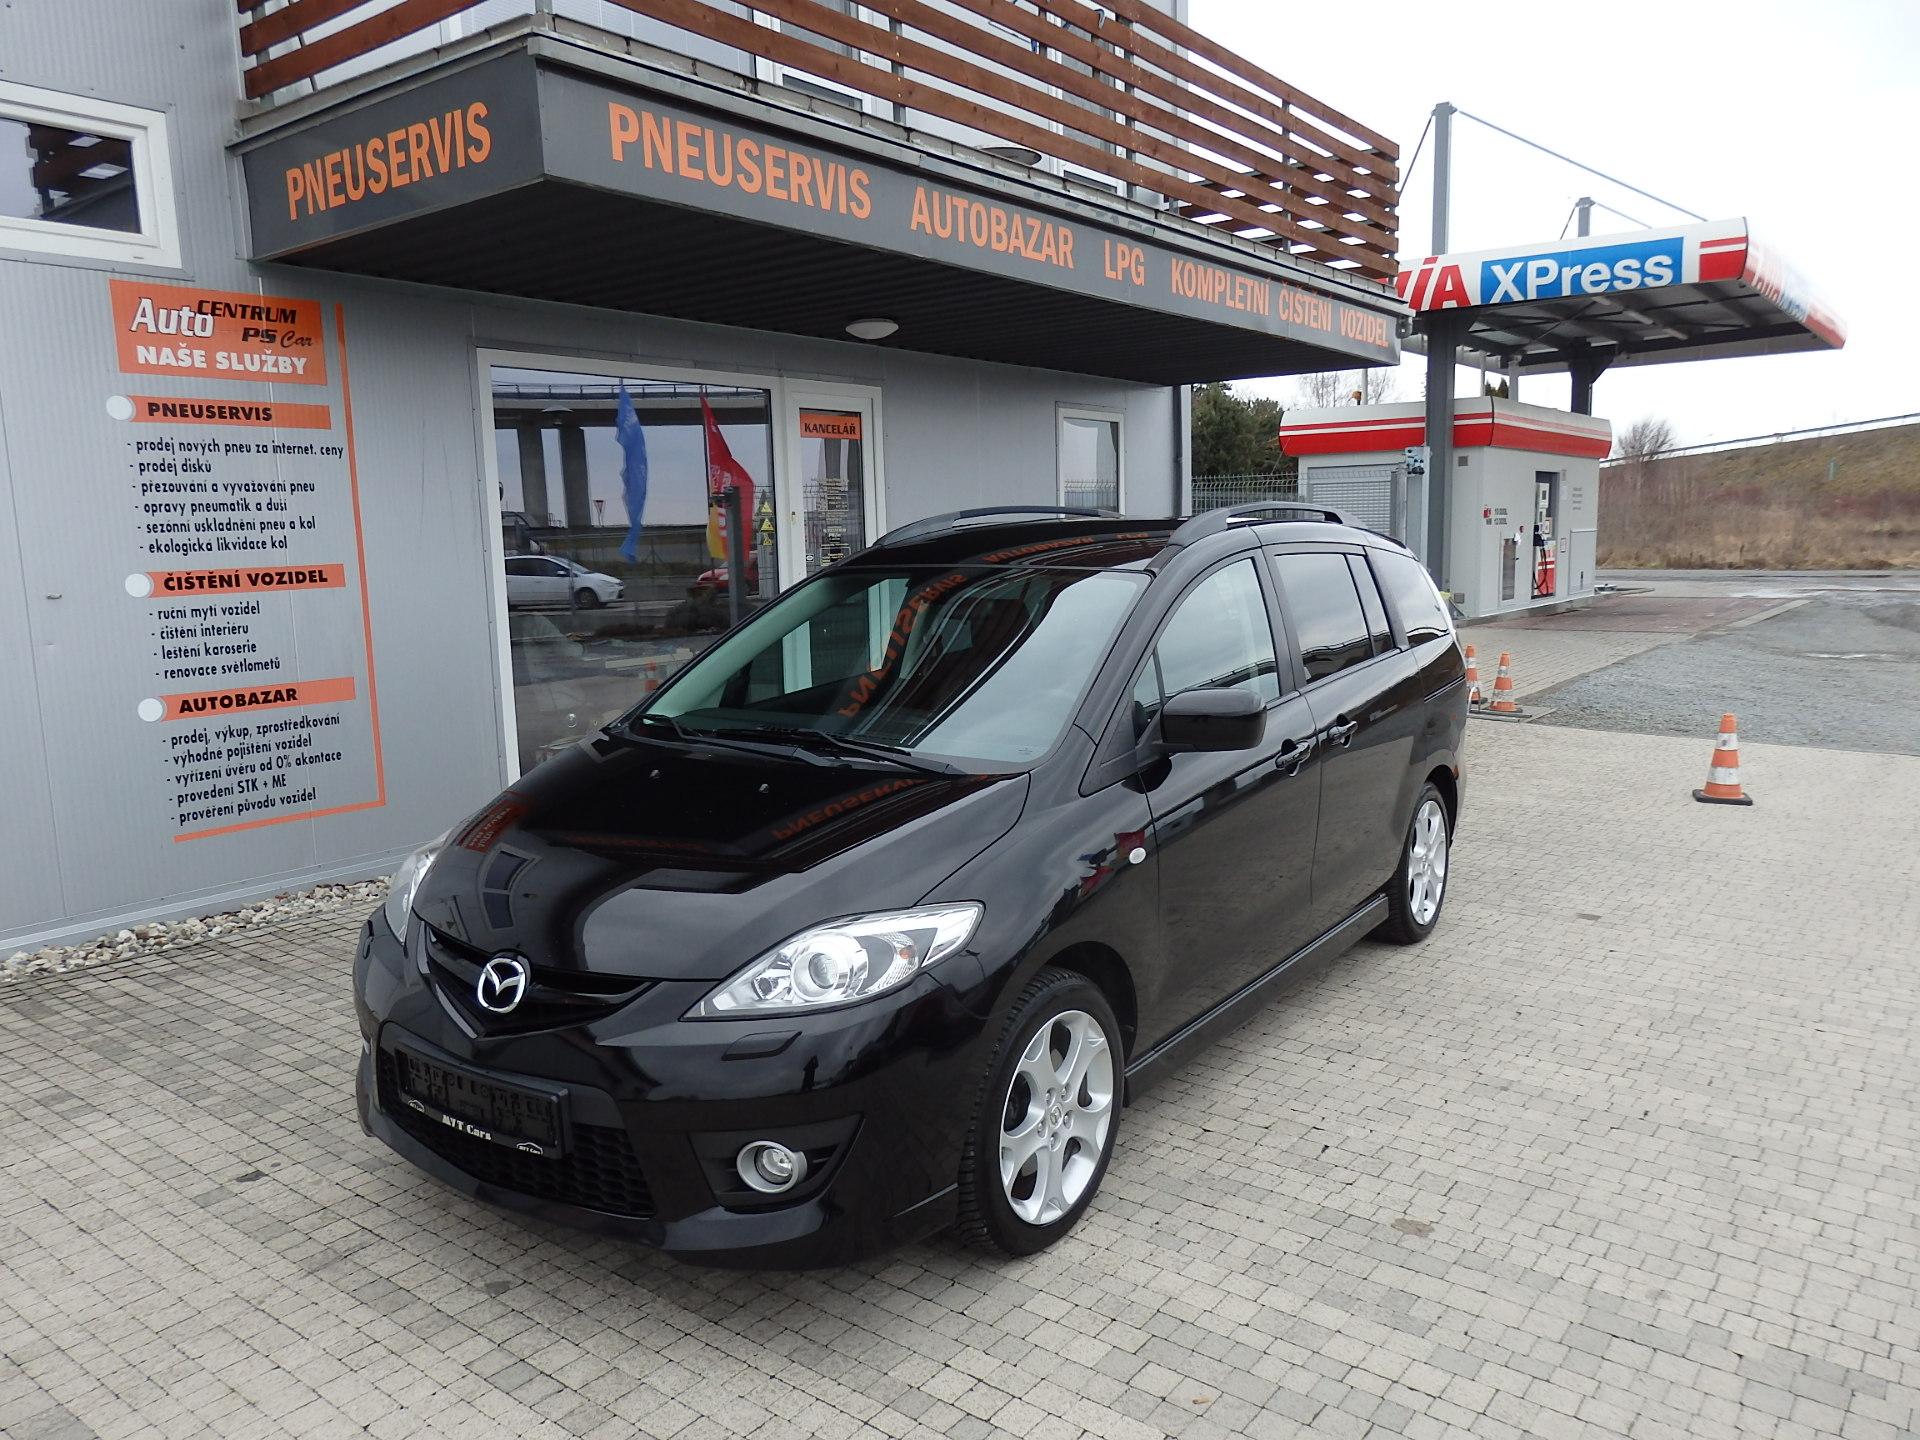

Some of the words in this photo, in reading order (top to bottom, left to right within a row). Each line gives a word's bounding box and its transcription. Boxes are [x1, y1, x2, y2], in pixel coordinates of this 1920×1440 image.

[285, 101, 493, 221] PNEUSERVIS
[607, 101, 872, 220] PNEUSERVIS
[910, 185, 1075, 270] AUTOBAZAR
[1104, 239, 1145, 287] LPG
[1170, 257, 1272, 316] KOMPLETNÍ
[1278, 280, 1333, 332] ČIŠTĚNÍ
[1339, 306, 1389, 348] VOZIDEL
[1488, 253, 1674, 304] XPress
[129, 297, 215, 338] Auto
[198, 299, 297, 324] CENTRUM
[241, 327, 278, 344] PS
[280, 330, 315, 348] Car
[137, 341, 208, 369] NAŠE
[215, 348, 308, 375] SLUŽBY
[147, 402, 272, 422] PNEUSERVIS
[804, 422, 857, 435] KANCELÁŘ
[136, 437, 175, 455] prodej
[179, 438, 220, 456] nových
[224, 442, 251, 456] pneu
[255, 444, 268, 454] za
[320, 445, 344, 459] ceny
[138, 458, 177, 476] prodej
[181, 458, 212, 474] disků
[141, 480, 207, 496] přezouvání
[211, 484, 218, 494] a
[223, 479, 286, 496] vyvažování
[290, 482, 316, 496] pneu
[144, 501, 186, 516] opravy
[190, 498, 252, 516] pneumatik
[255, 502, 263, 512] a
[194, 517, 256, 533] uskladnění
[259, 519, 286, 533] pneu
[289, 520, 296, 530] a
[299, 516, 316, 530] kol
[149, 538, 213, 556] ekologická
[217, 536, 267, 552] likvidace
[271, 535, 288, 550] kol
[163, 570, 241, 591] ČIŠTĚNÍ
[247, 569, 328, 586] VOZIDEL
[158, 605, 187, 620] ruční
[221, 600, 260, 616] vozidel
[160, 625, 197, 640] čištění
[200, 621, 249, 637] interiéru
[161, 643, 200, 660] leštění
[204, 639, 257, 657] karoserie
[164, 664, 217, 679] renovace
[221, 656, 281, 674] světlometů
[179, 688, 298, 714] AUTOBAZAR
[171, 728, 211, 749] prodej,
[256, 712, 341, 738] zprostředkování
[173, 746, 223, 768] výhodné
[226, 739, 272, 762] pojištění
[275, 733, 312, 751] vozidel
[259, 756, 273, 772] od
[276, 754, 292, 769] 0%
[295, 750, 342, 767] akontace
[177, 780, 234, 807] provedení
[237, 778, 259, 794] STK
[272, 773, 287, 789] ME
[179, 800, 234, 827] prověření
[237, 795, 276, 816] původu
[279, 787, 317, 806] vozidel
[466, 1124, 492, 1140] Cars
